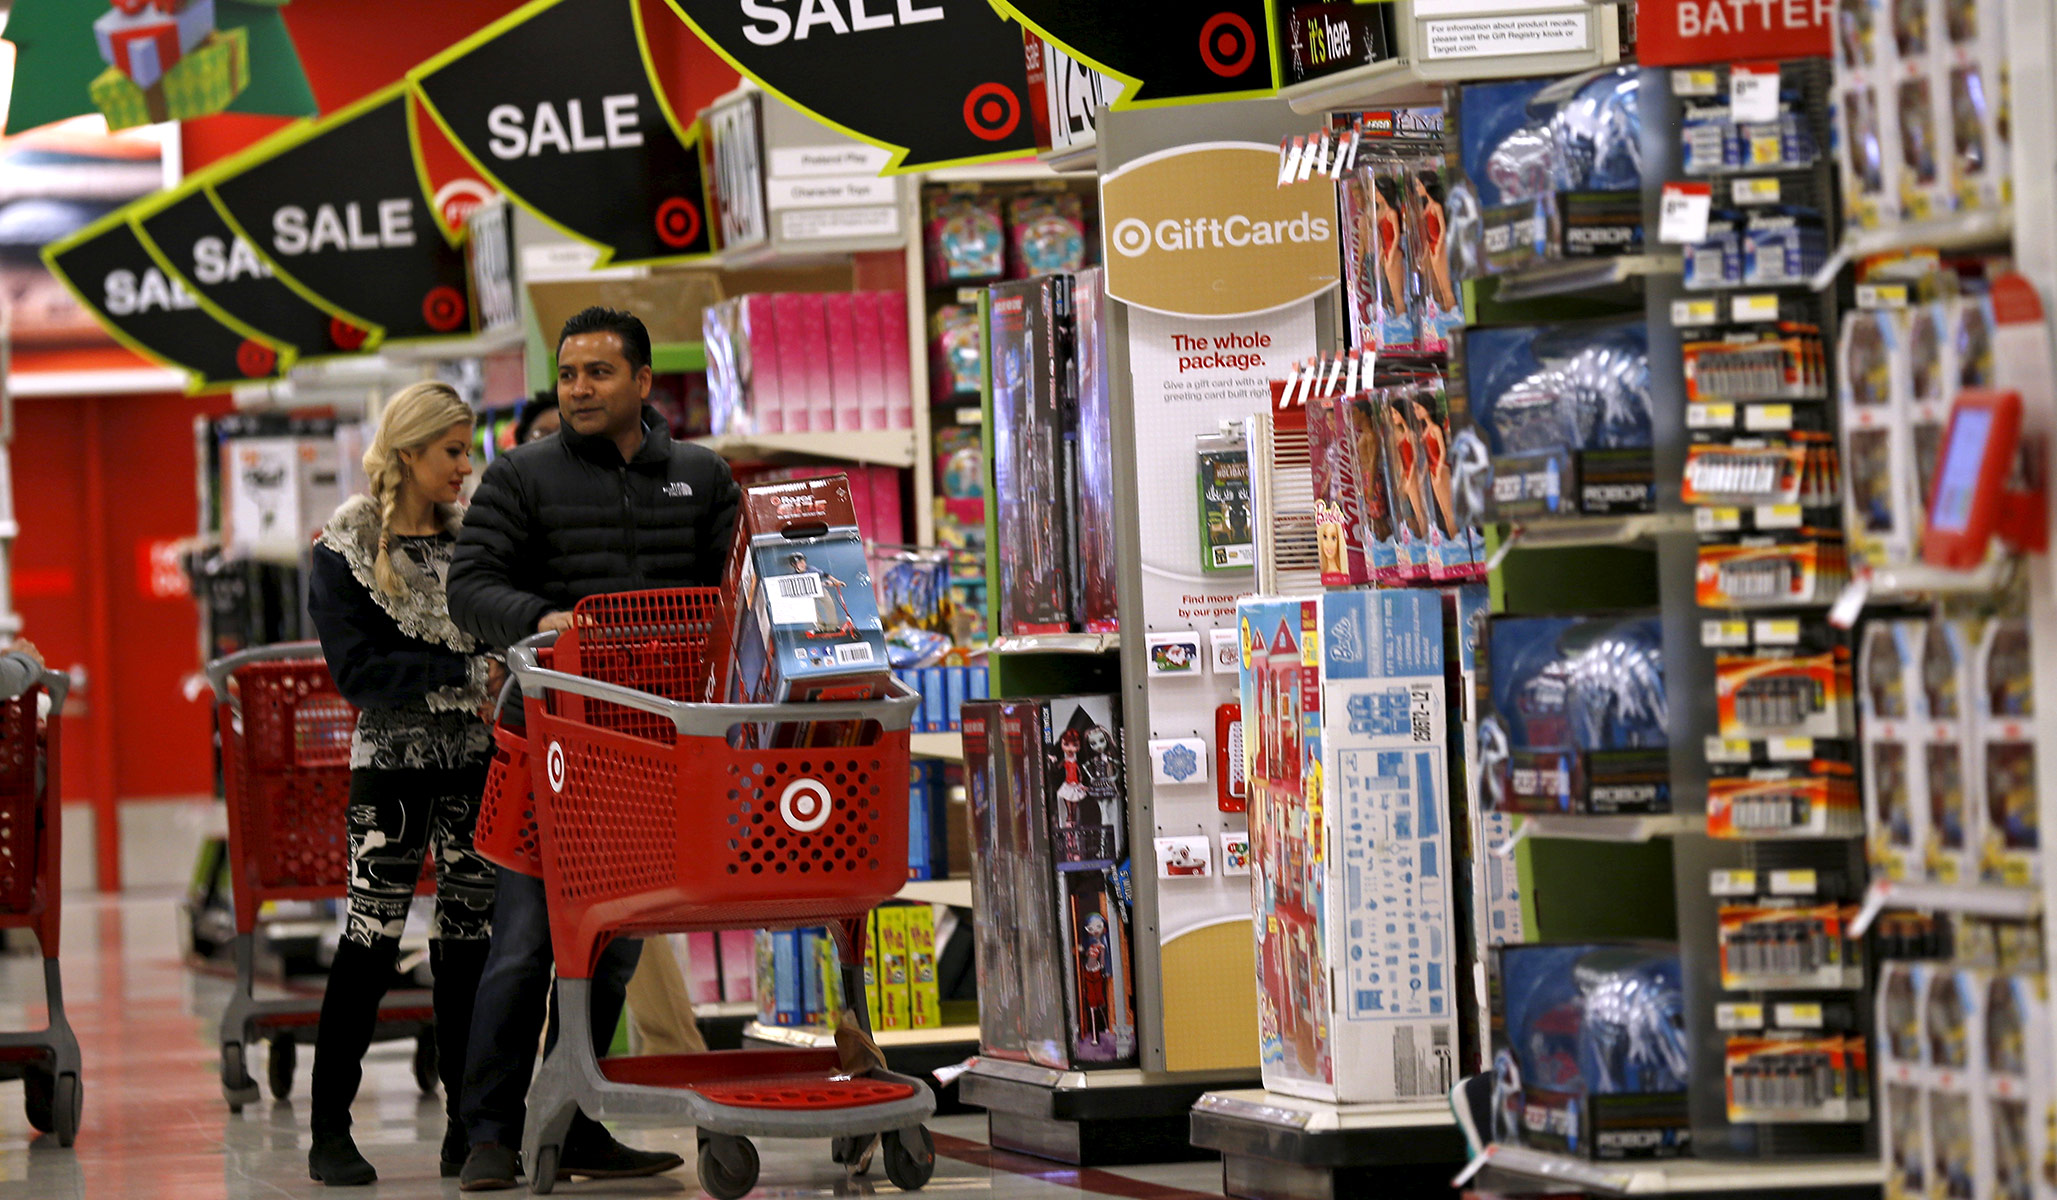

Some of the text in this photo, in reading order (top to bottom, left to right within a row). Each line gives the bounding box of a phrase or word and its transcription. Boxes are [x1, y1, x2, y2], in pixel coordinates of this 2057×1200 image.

[741, 0, 944, 46] SALE
[1431, 18, 1578, 33] For information about product recalls,
[1432, 35, 1458, 44] please
[1460, 33, 1476, 41] visit
[1477, 32, 1490, 40] the
[1492, 31, 1506, 40] Gift
[1508, 29, 1541, 40] Registry
[1543, 28, 1563, 38] kiosk
[1307, 14, 1352, 64] it's here
[487, 94, 644, 160] SALE
[272, 199, 416, 255] SALE
[1155, 211, 1330, 251] GiftCards
[193, 235, 276, 284] SA
[104, 268, 200, 315] SAL
[1171, 331, 1272, 351] The whole
[1178, 352, 1266, 373] package.
[1163, 380, 1184, 390] Give
[1195, 379, 1209, 390] gift
[1212, 378, 1233, 388] card
[1235, 376, 1258, 386] with
[1163, 387, 1271, 403] greeting card built right
[1178, 607, 1191, 618] by
[1194, 608, 1210, 617] our
[1182, 593, 1205, 604] Find
[1207, 594, 1234, 604] more
[1330, 616, 1354, 664] Barbie
